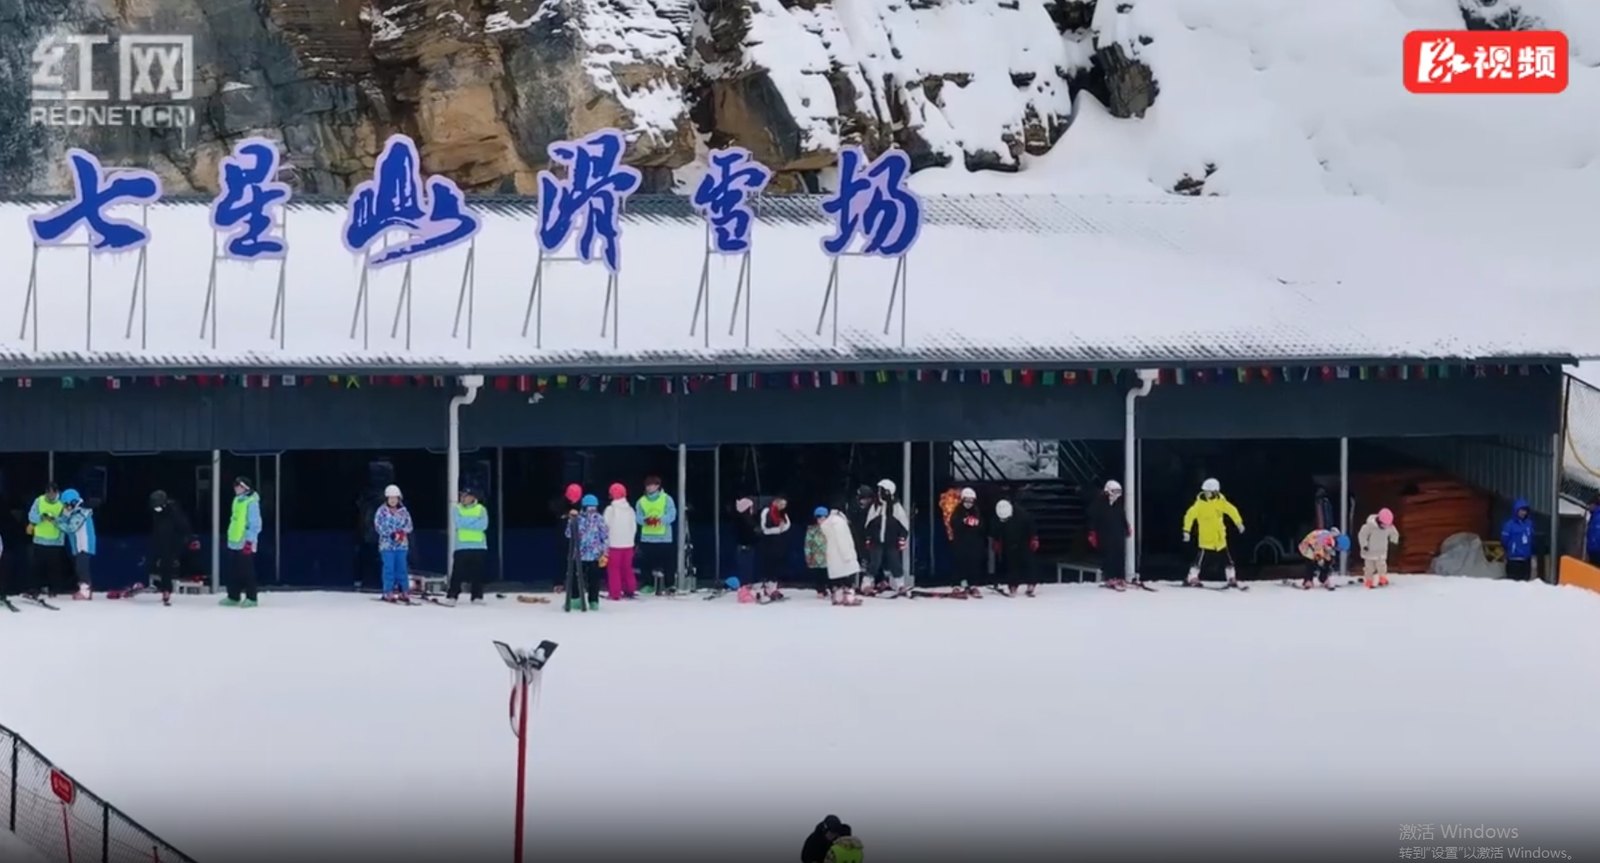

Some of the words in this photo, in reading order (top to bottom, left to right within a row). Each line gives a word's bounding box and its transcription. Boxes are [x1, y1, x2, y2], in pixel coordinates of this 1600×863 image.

[30, 130, 923, 272] 七星山滑雪场
